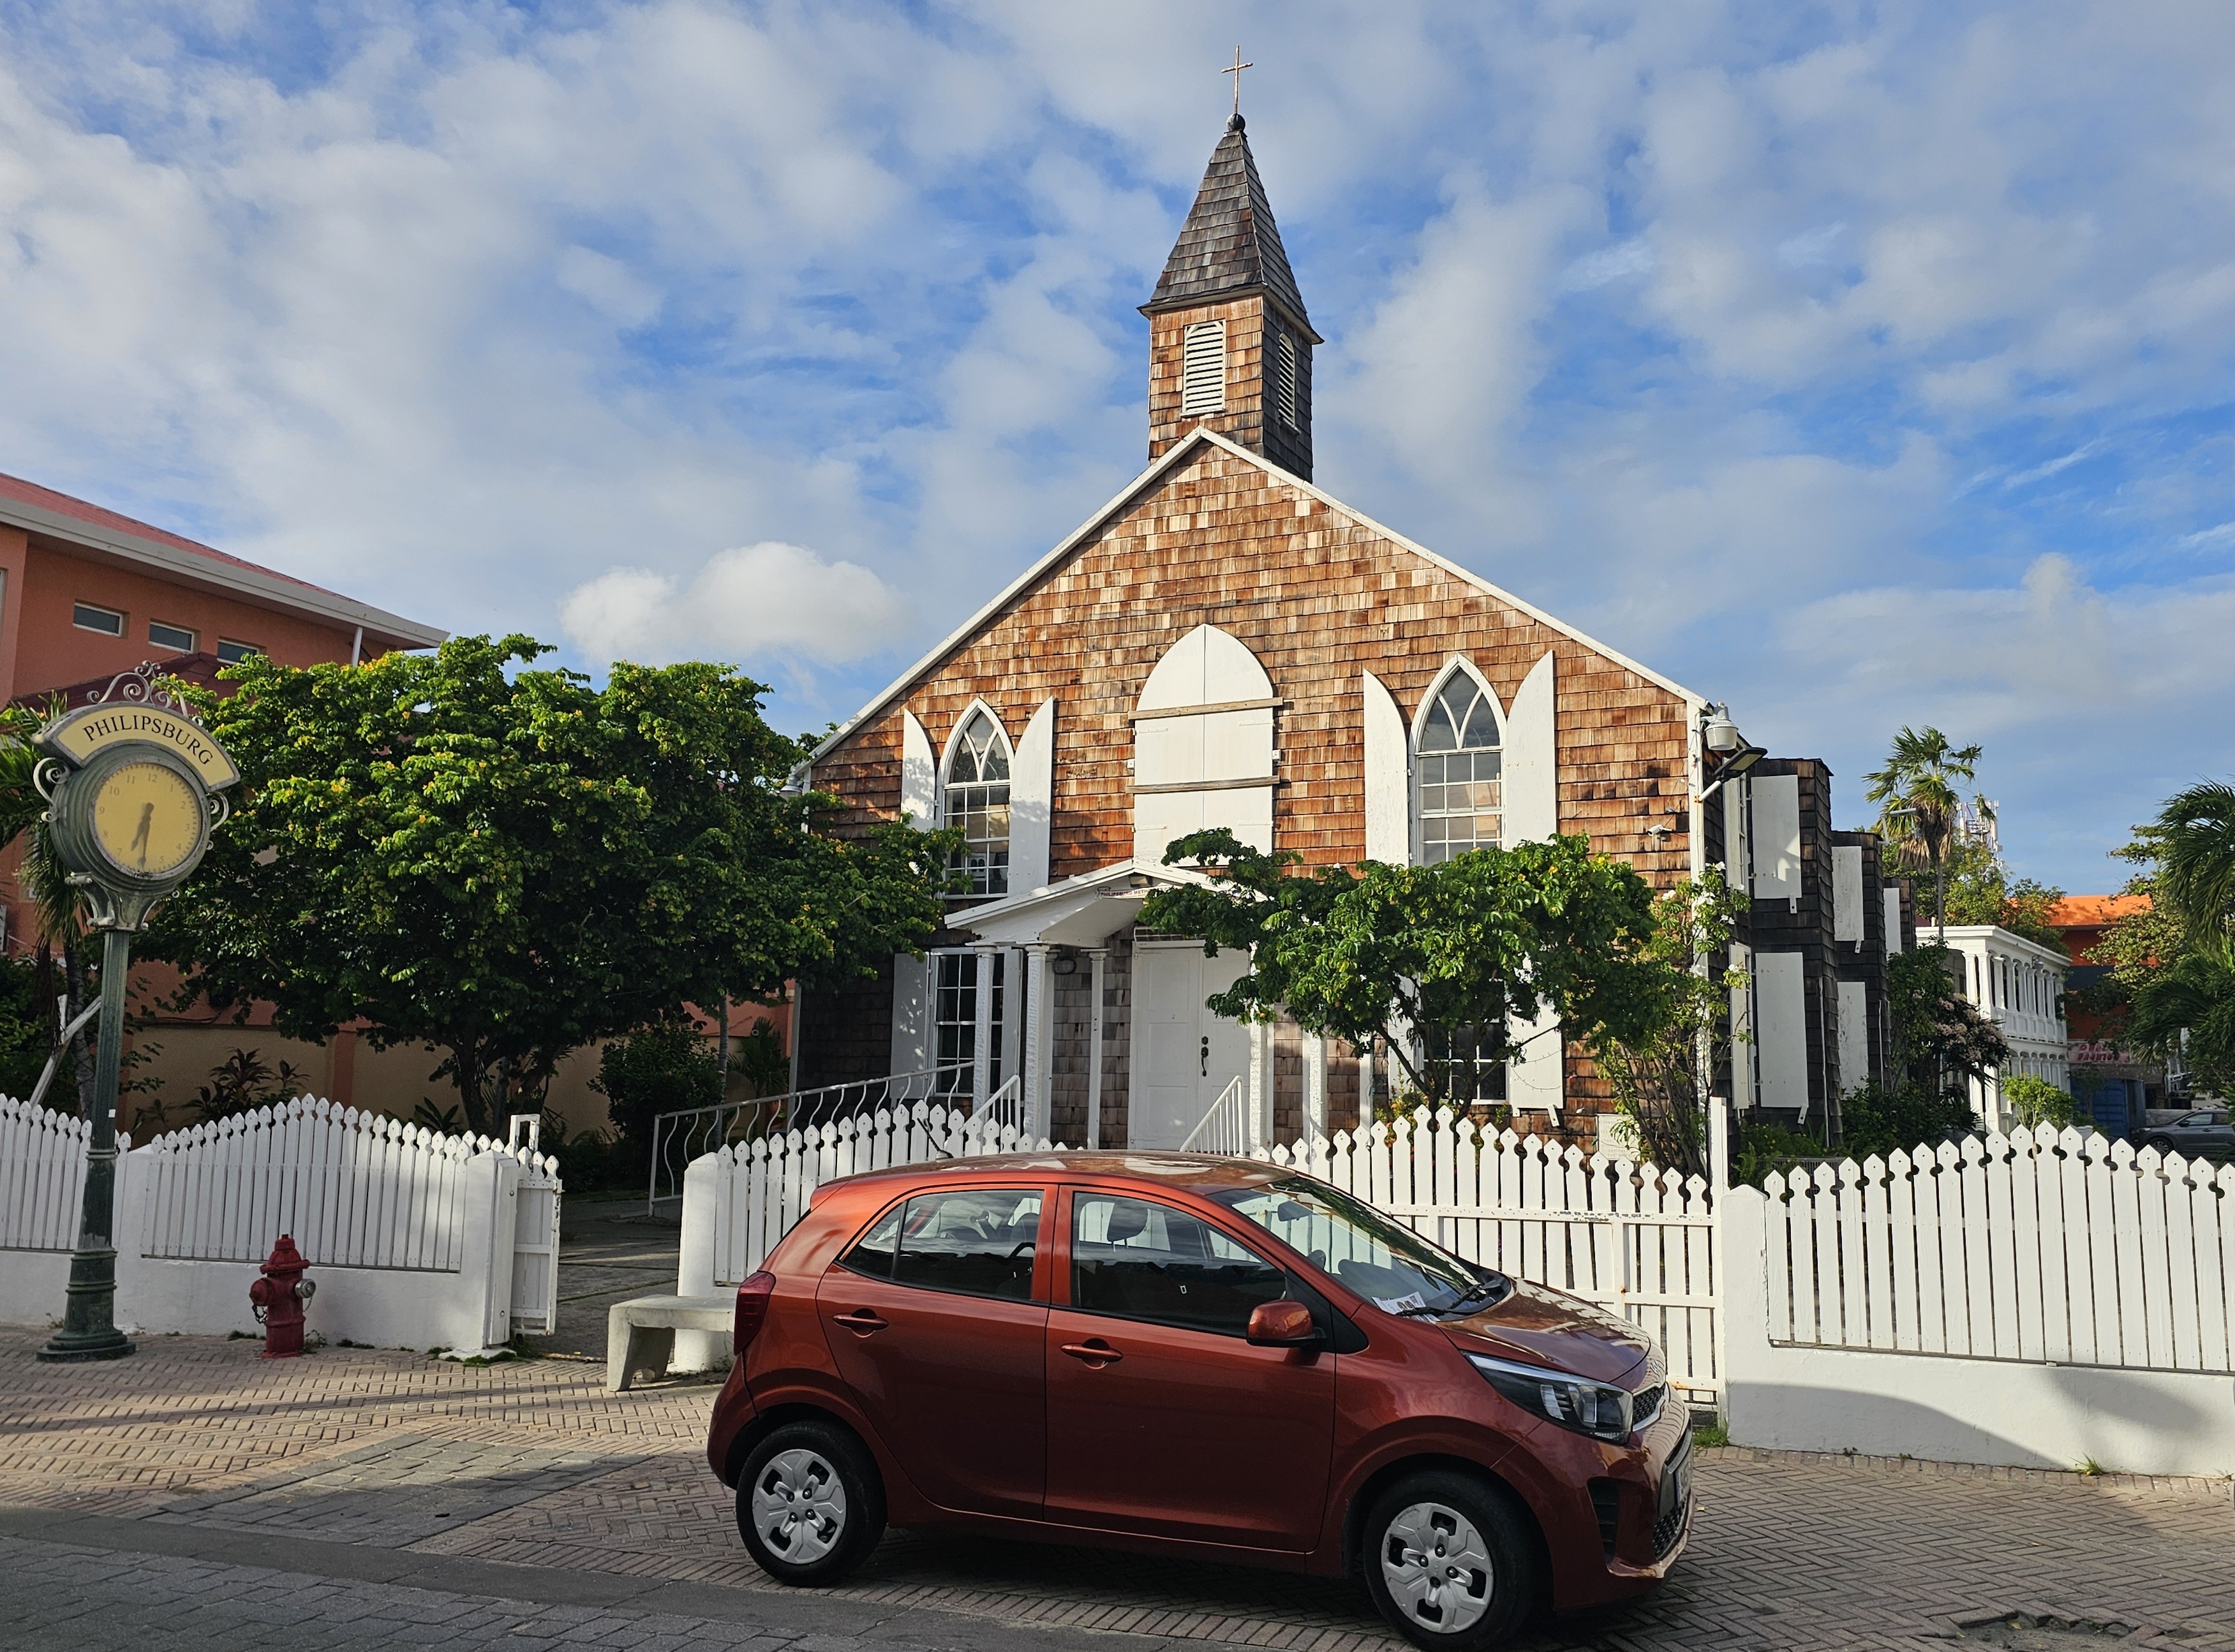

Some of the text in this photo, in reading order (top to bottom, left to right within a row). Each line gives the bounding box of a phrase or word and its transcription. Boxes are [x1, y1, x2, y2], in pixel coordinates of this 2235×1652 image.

[82, 715, 213, 765] PHILIPSBURG
[126, 775, 136, 785] 11
[147, 773, 158, 783] 12
[108, 786, 120, 796] 10
[169, 784, 174, 792] 1
[180, 801, 186, 809] 2
[99, 806, 105, 815] 9
[184, 823, 190, 832] 3
[103, 830, 109, 839] 8
[175, 843, 182, 851] 4
[115, 847, 123, 857] 7
[159, 855, 166, 864] 5
